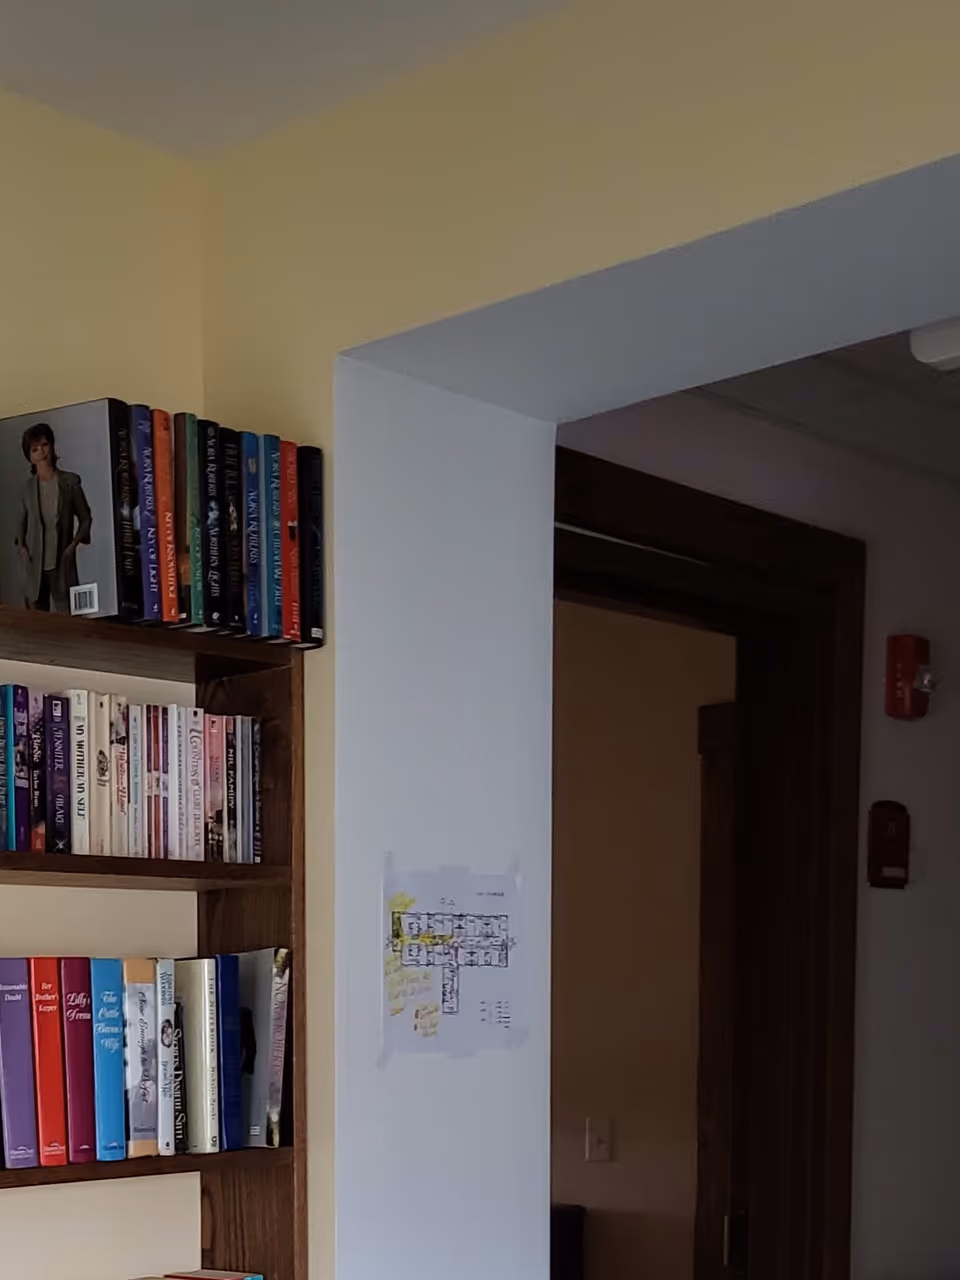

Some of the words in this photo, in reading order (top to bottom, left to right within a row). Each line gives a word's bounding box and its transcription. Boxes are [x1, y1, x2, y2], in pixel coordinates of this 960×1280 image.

[143, 446, 153, 473] NORA
[139, 473, 154, 510] ROBERTS
[207, 463, 218, 496] ROBERTS
[248, 488, 259, 517] NORA
[147, 527, 156, 545] KEY
[209, 526, 219, 567] NORTHERN
[247, 521, 259, 563] ROBERTS
[149, 564, 158, 592] LIGHT
[209, 570, 220, 597] LIGHTS
[76, 724, 84, 735] MY
[31, 733, 42, 762] Birdie
[52, 727, 64, 771] JENNIFER
[55, 794, 66, 826] BLAKE
[77, 797, 86, 819] SELF
[138, 991, 147, 1014] Close
[274, 982, 286, 1017] NORA
[138, 1018, 149, 1054] Enough
[272, 1022, 285, 1074] ROBERTS
